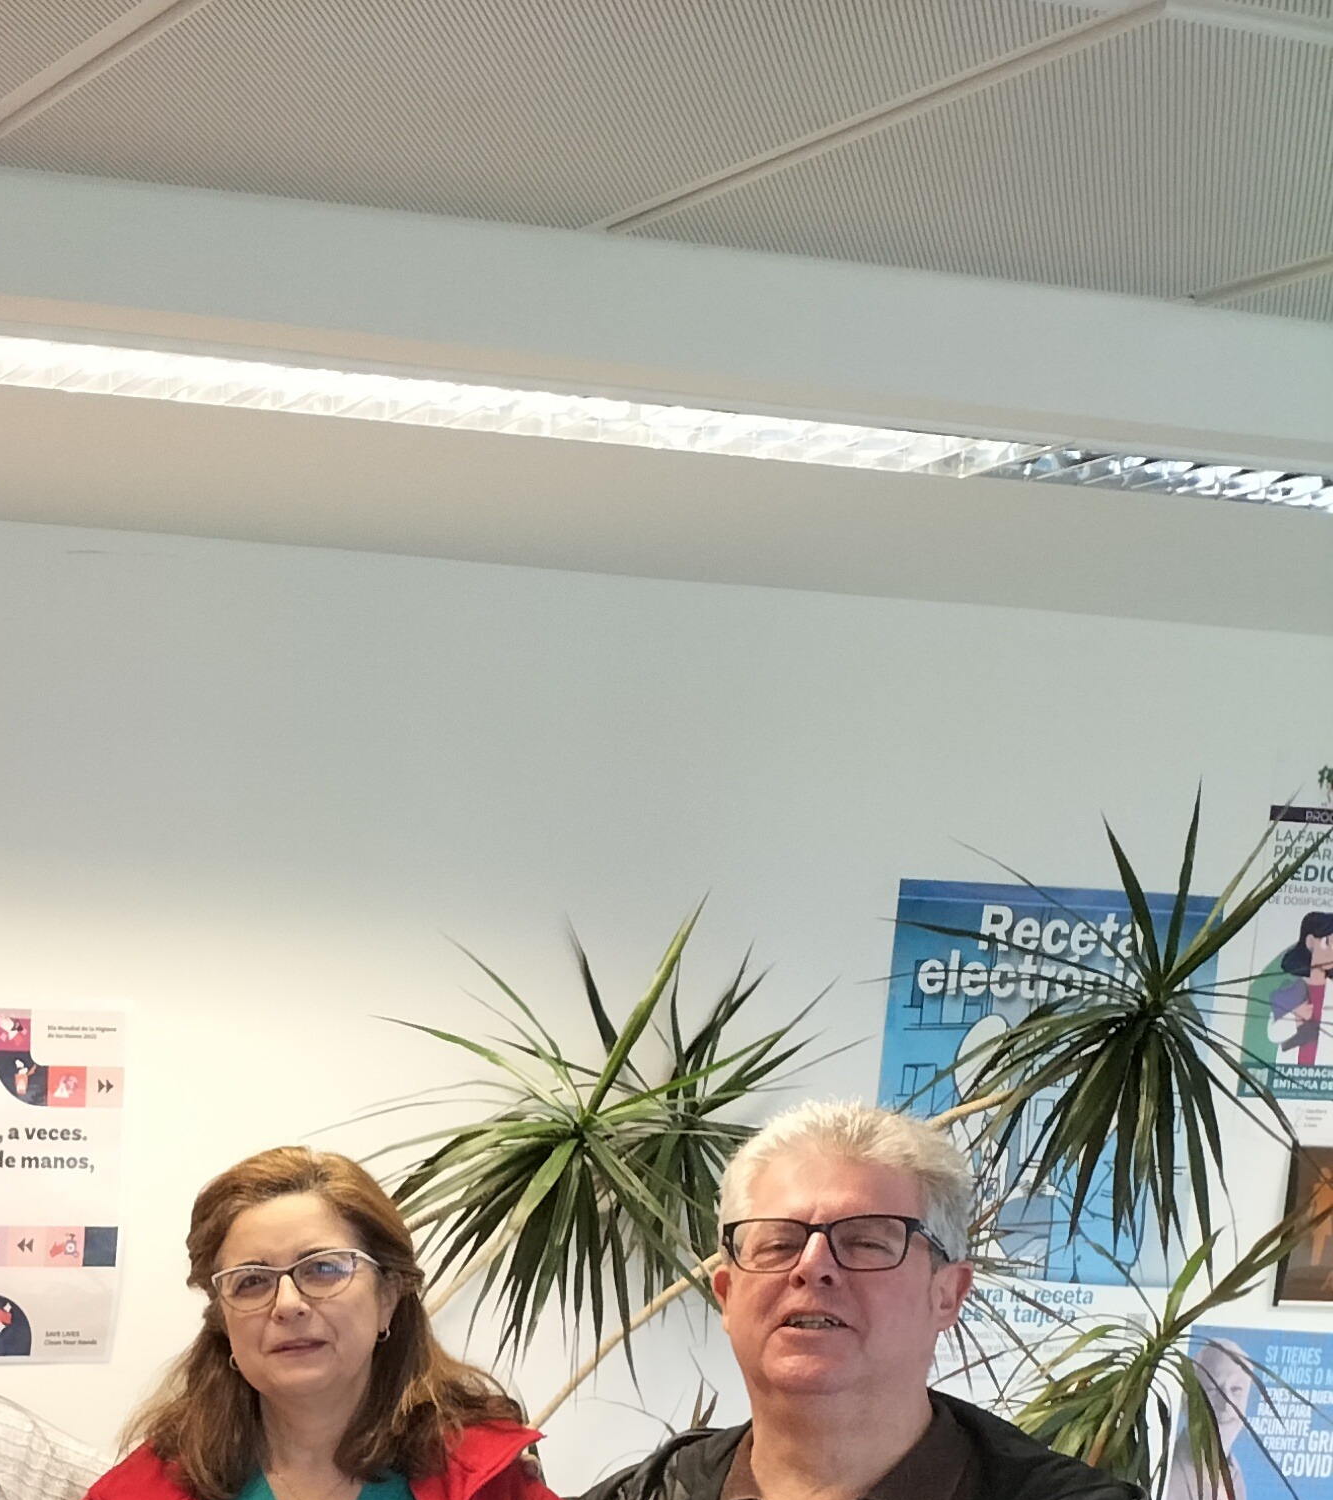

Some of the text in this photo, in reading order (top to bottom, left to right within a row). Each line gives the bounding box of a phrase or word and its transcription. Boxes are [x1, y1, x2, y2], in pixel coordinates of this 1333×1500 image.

[1276, 829, 1292, 841] LA
[979, 905, 1144, 958] Receta
[8, 1128, 19, 1139] a
[25, 1128, 87, 1140] veces.
[21, 1157, 94, 1173] manos,
[1034, 1287, 1094, 1304] receta
[1265, 1345, 1322, 1364] SI TIENES
[1281, 1366, 1312, 1385] AÑOS
[1288, 1404, 1311, 1418] PARA
[1263, 1436, 1297, 1451] FRENTE
